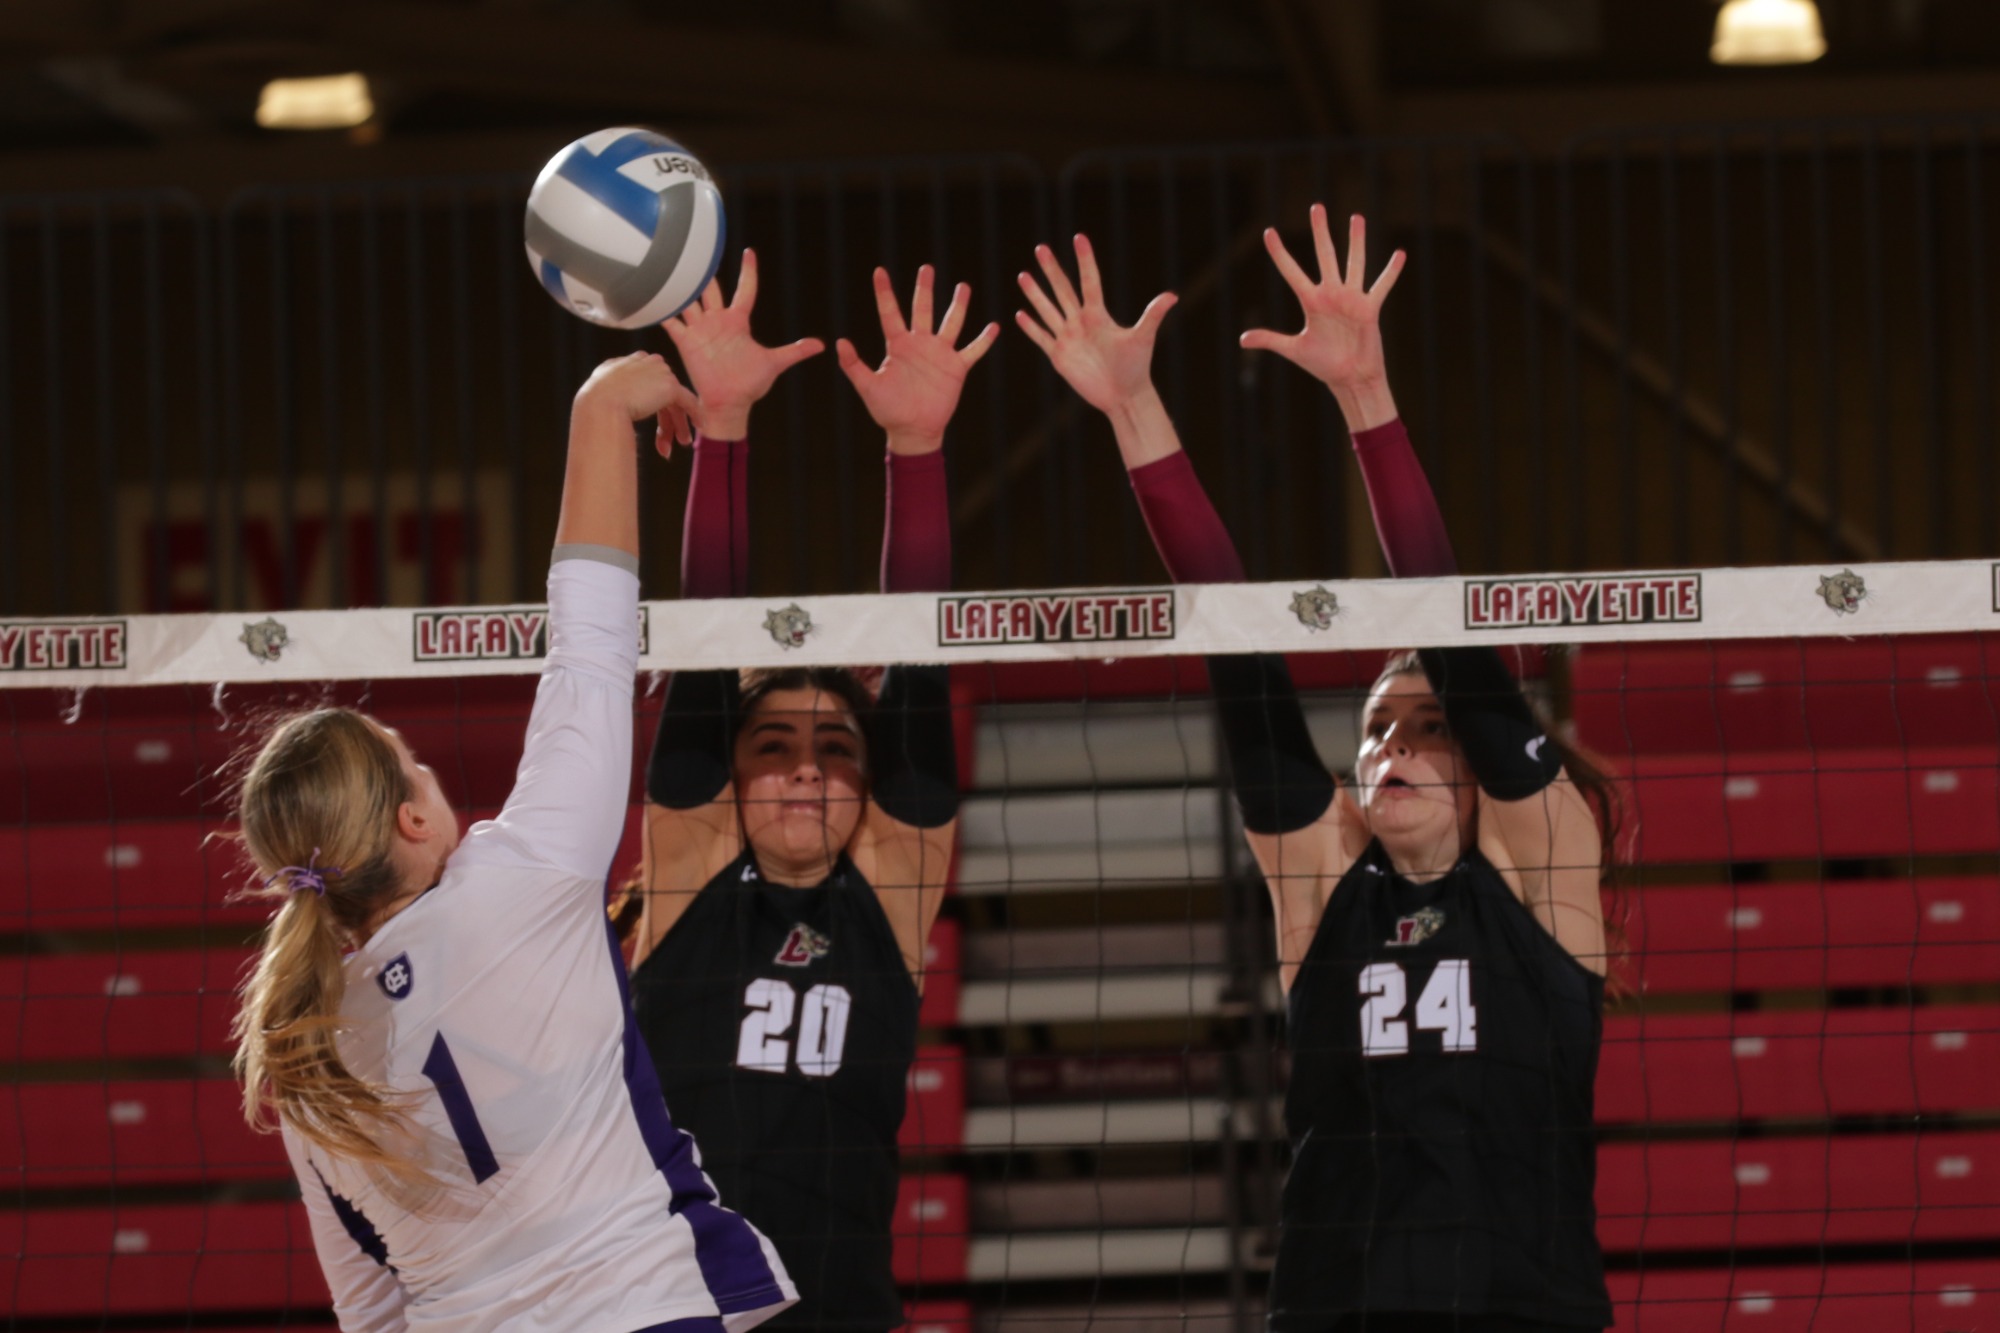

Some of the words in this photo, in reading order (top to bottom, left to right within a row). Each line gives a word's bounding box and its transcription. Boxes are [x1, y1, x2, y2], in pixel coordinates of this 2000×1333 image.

[941, 597, 1173, 643] LAFAYETTE
[1468, 576, 1699, 627] LAFAYETTE
[736, 978, 852, 1077] 20
[1358, 959, 1477, 1057] 24
[421, 1029, 501, 1186] 1
